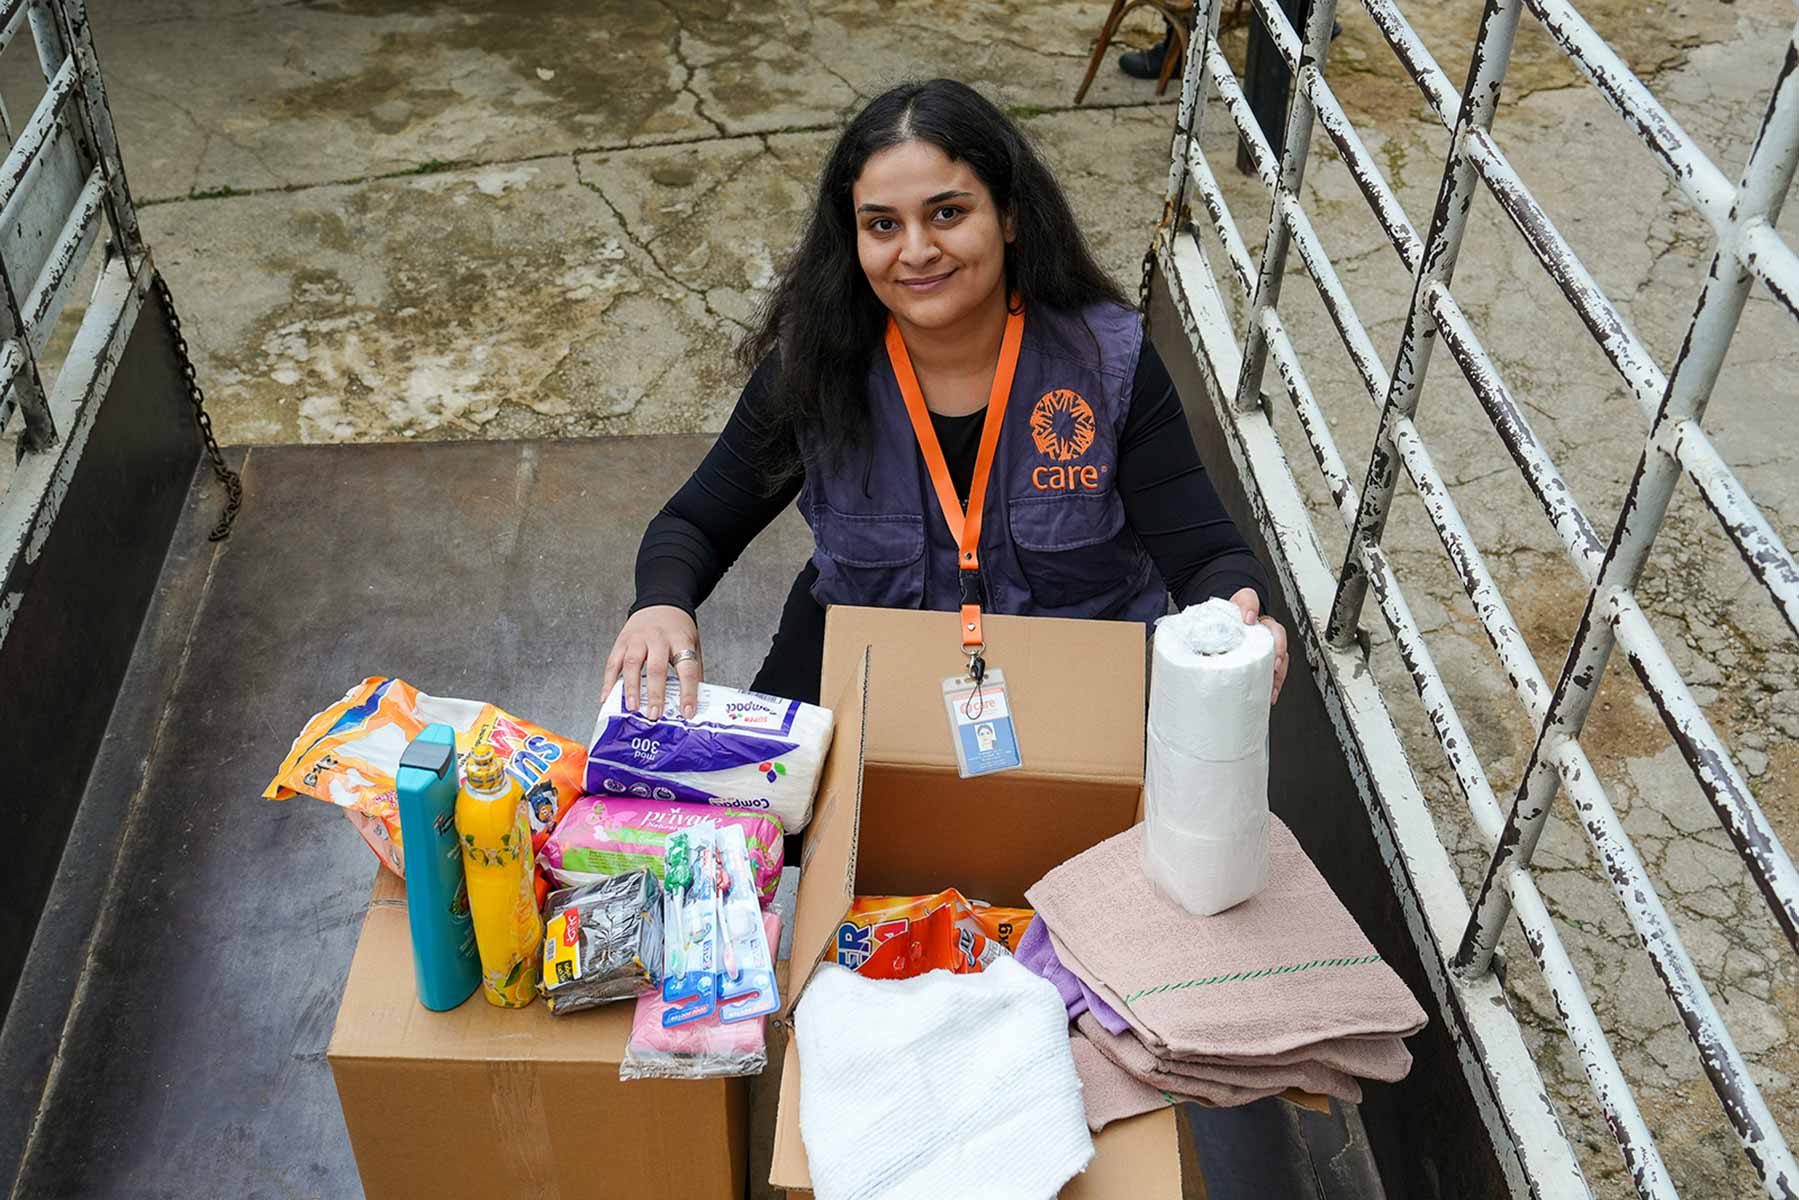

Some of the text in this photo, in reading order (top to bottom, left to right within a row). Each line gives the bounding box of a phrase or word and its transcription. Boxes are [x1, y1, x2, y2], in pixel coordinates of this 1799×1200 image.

[1032, 465, 1099, 490] care
[631, 737, 661, 754] 300
[634, 751, 657, 761] mod
[640, 809, 724, 828] private
